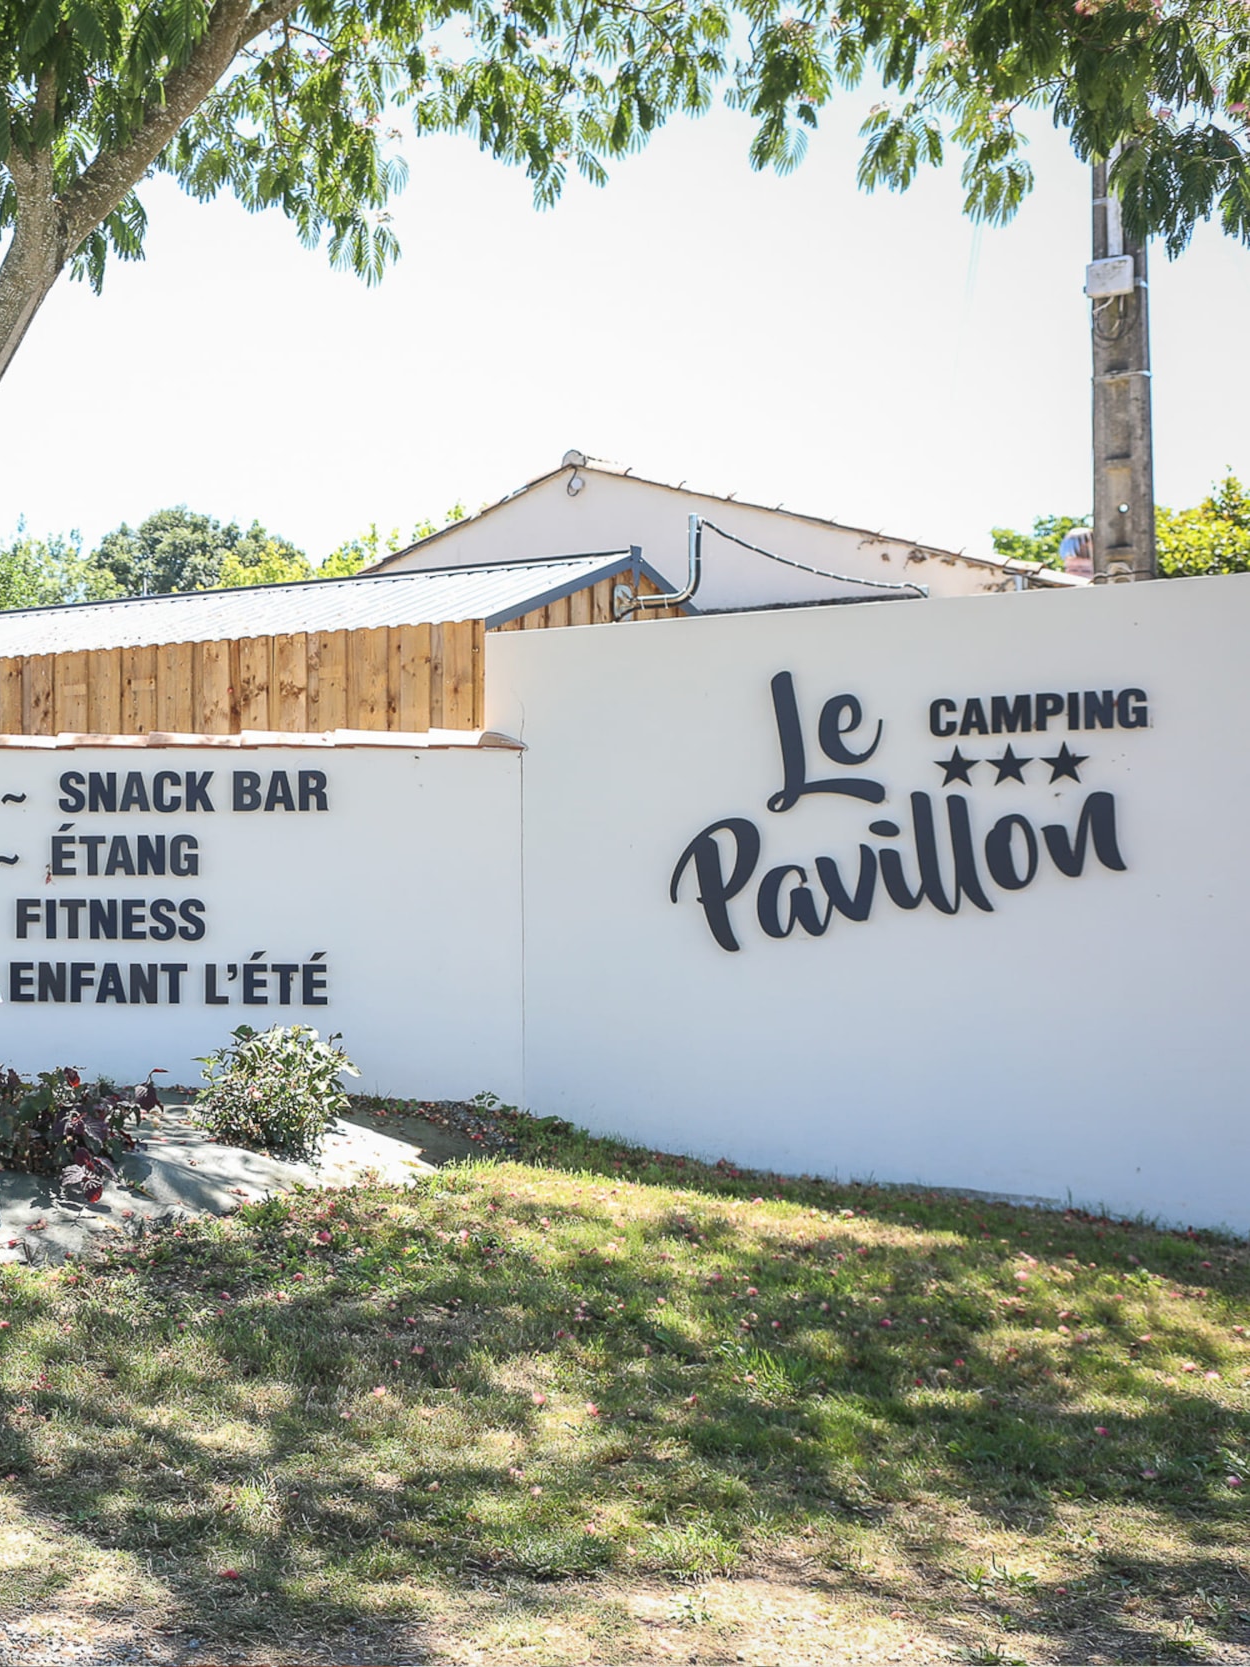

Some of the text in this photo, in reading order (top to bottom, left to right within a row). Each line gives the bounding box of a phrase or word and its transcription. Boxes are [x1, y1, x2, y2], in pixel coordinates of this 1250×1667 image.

[929, 688, 1149, 737] CAMPING
[767, 671, 886, 813] Le
[58, 771, 215, 813] SNACK
[232, 771, 329, 812] BAR
[51, 823, 199, 877] ÉTANG
[670, 791, 1127, 952] Pavillon
[16, 898, 206, 941] FITNESS
[9, 951, 328, 1006] ENFANT L'ÉTÉ
